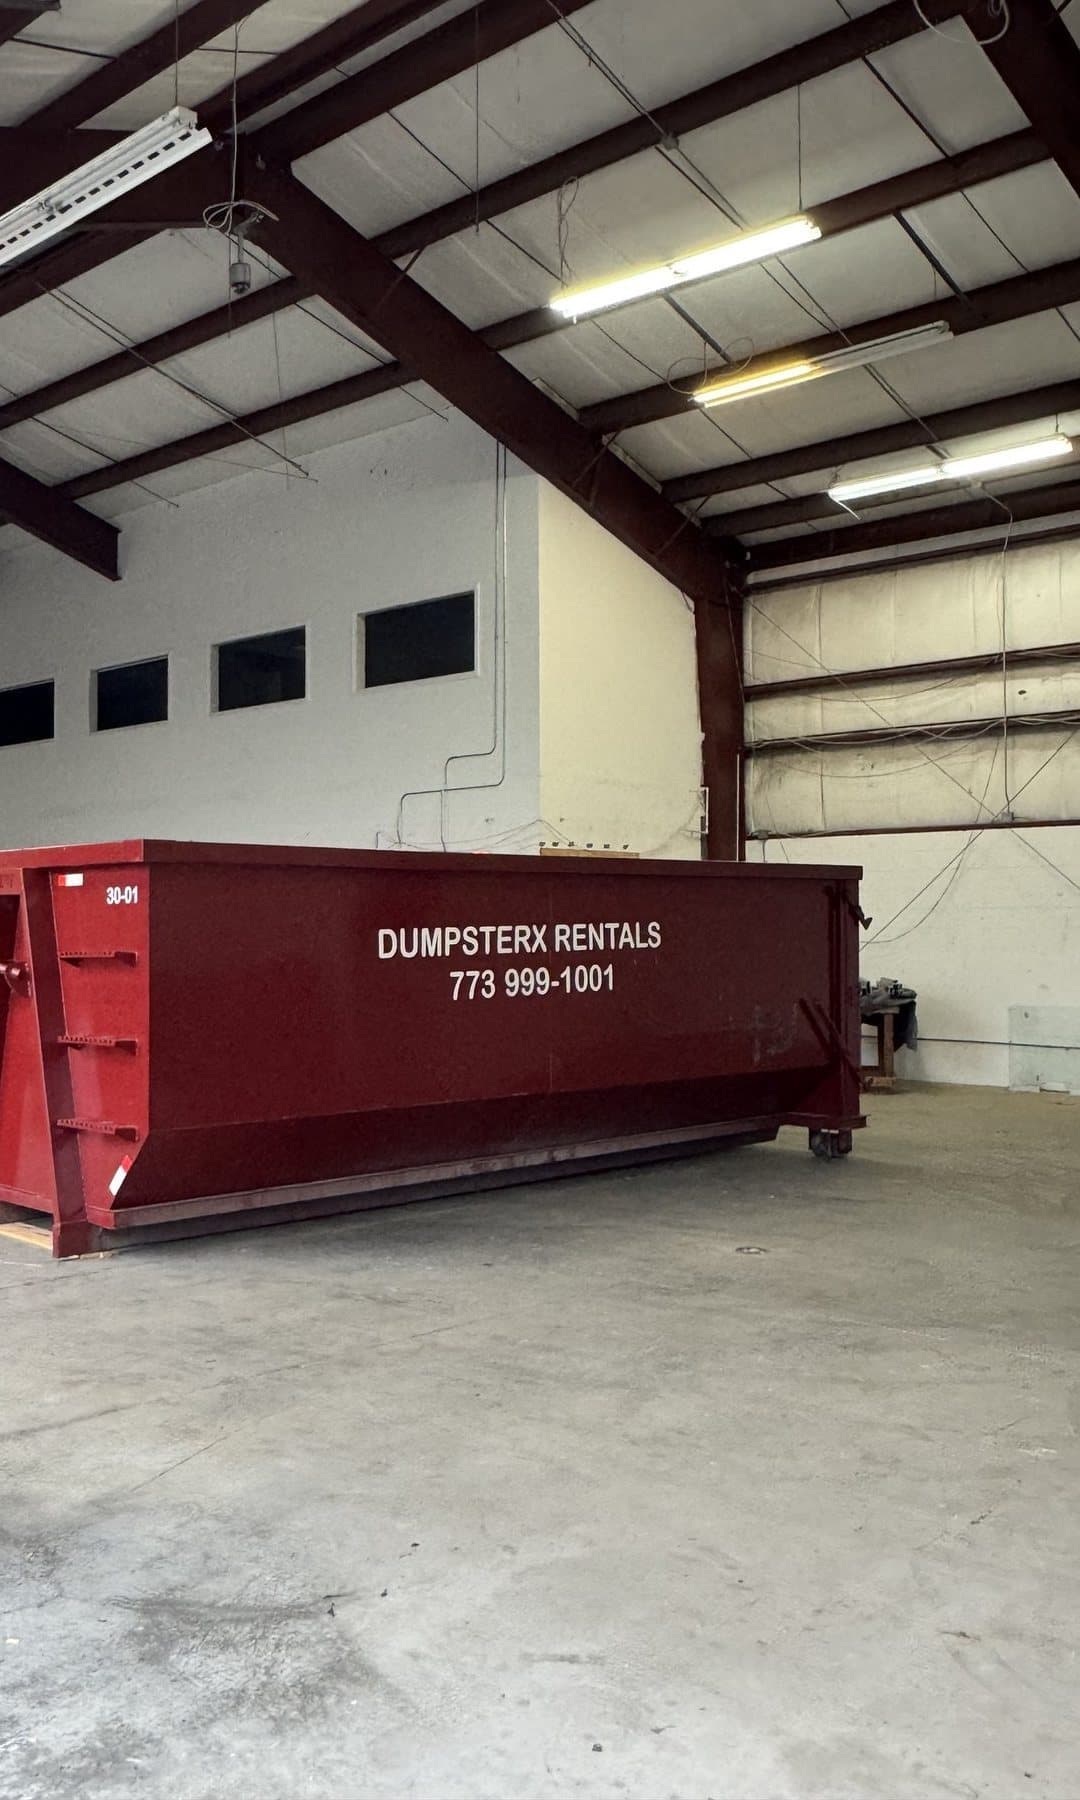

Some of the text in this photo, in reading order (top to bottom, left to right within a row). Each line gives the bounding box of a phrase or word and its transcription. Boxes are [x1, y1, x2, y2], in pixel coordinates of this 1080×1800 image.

[105, 885, 139, 905] 30-01
[377, 921, 663, 959] DUMPSTERX RENTALS
[449, 963, 615, 1001] 773 999-1001
